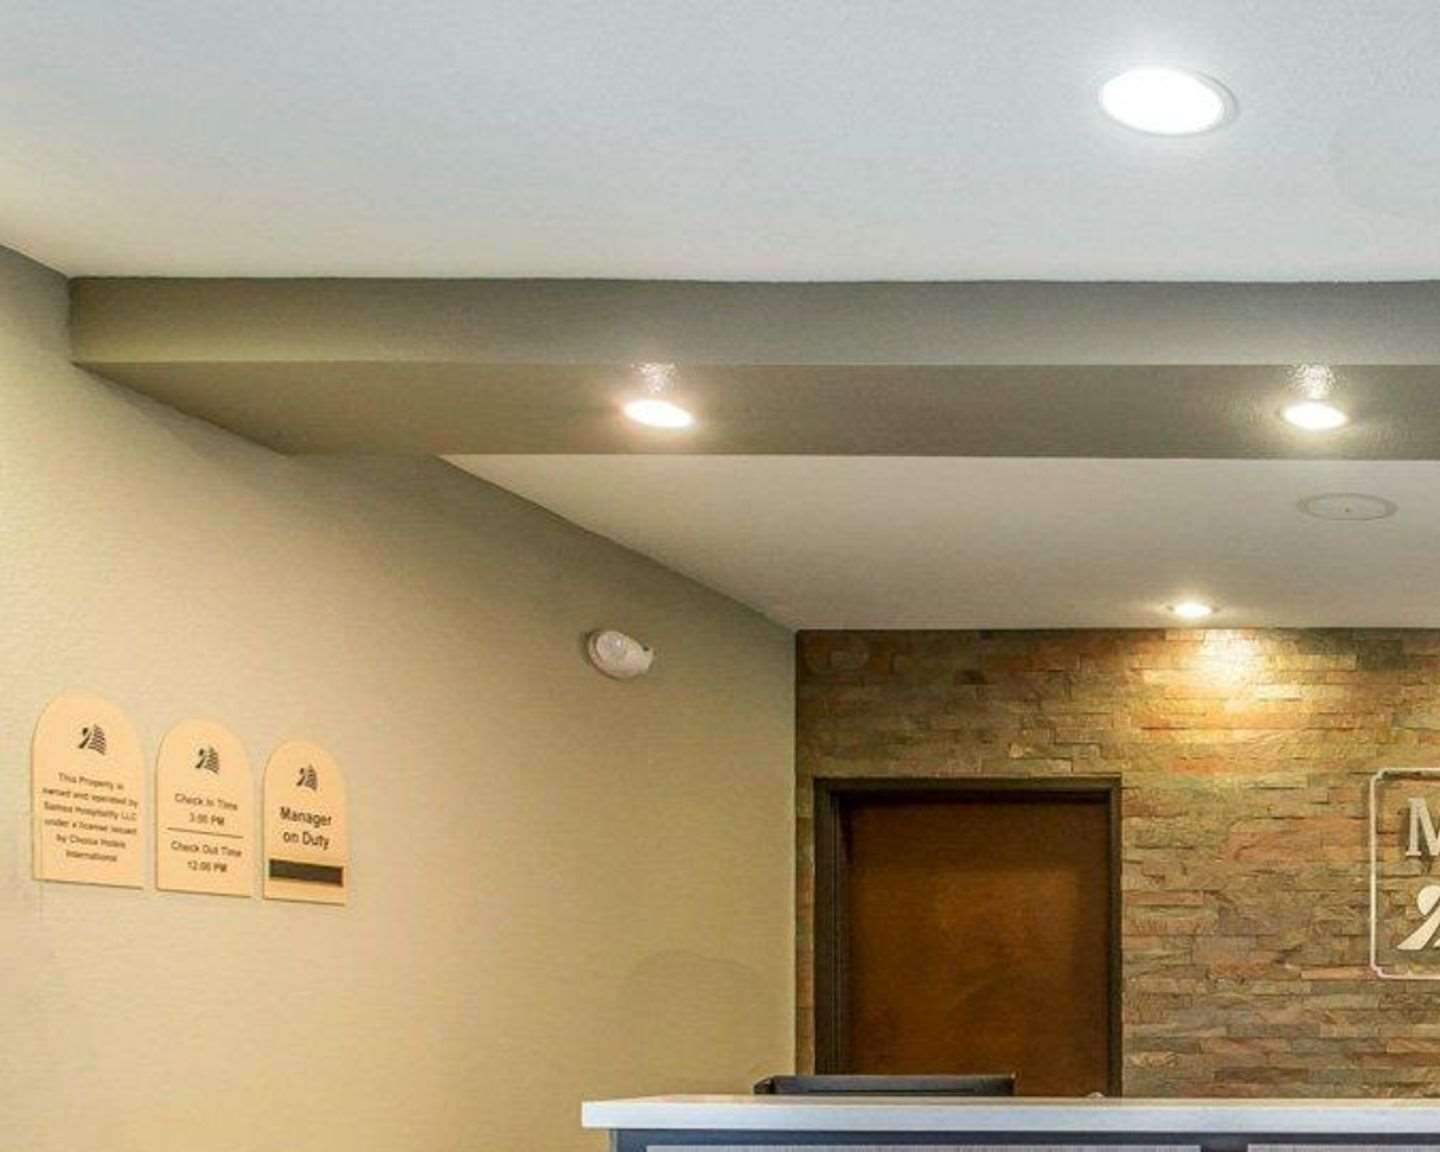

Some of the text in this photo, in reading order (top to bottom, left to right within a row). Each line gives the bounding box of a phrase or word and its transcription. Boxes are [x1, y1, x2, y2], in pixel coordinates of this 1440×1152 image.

[280, 806, 332, 829] Manager
[283, 831, 331, 851] on Duty
